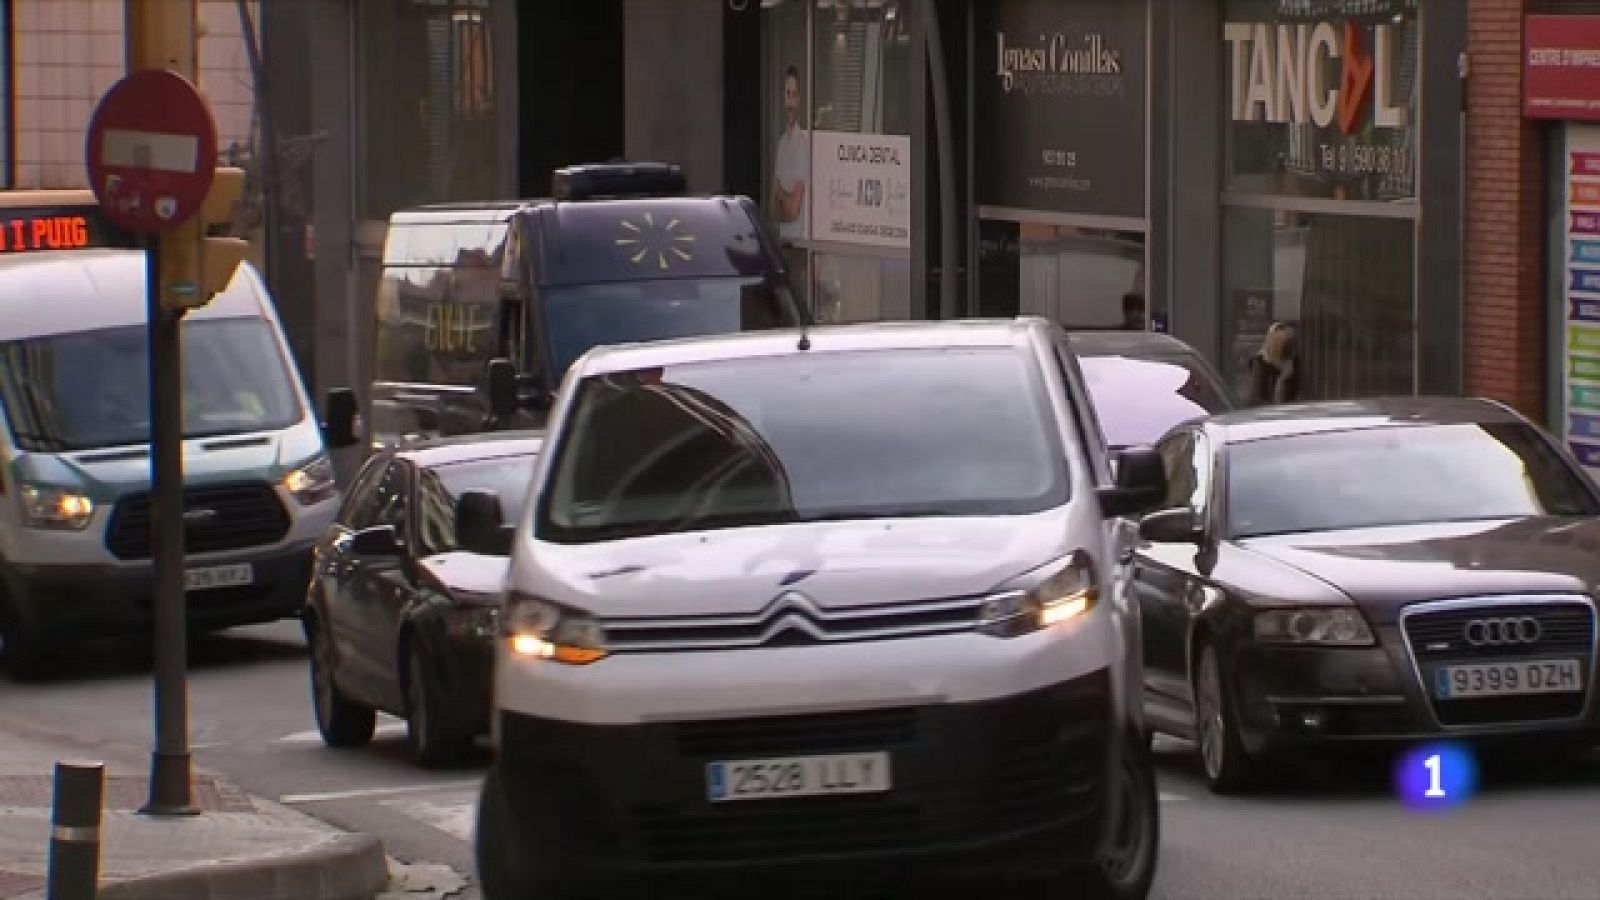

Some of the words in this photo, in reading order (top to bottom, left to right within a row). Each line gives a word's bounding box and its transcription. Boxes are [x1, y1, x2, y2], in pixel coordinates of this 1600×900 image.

[31, 216, 87, 249] PUIG
[1453, 666, 1519, 692] 9399
[732, 763, 804, 795] 2528
[819, 758, 874, 788] LLY
